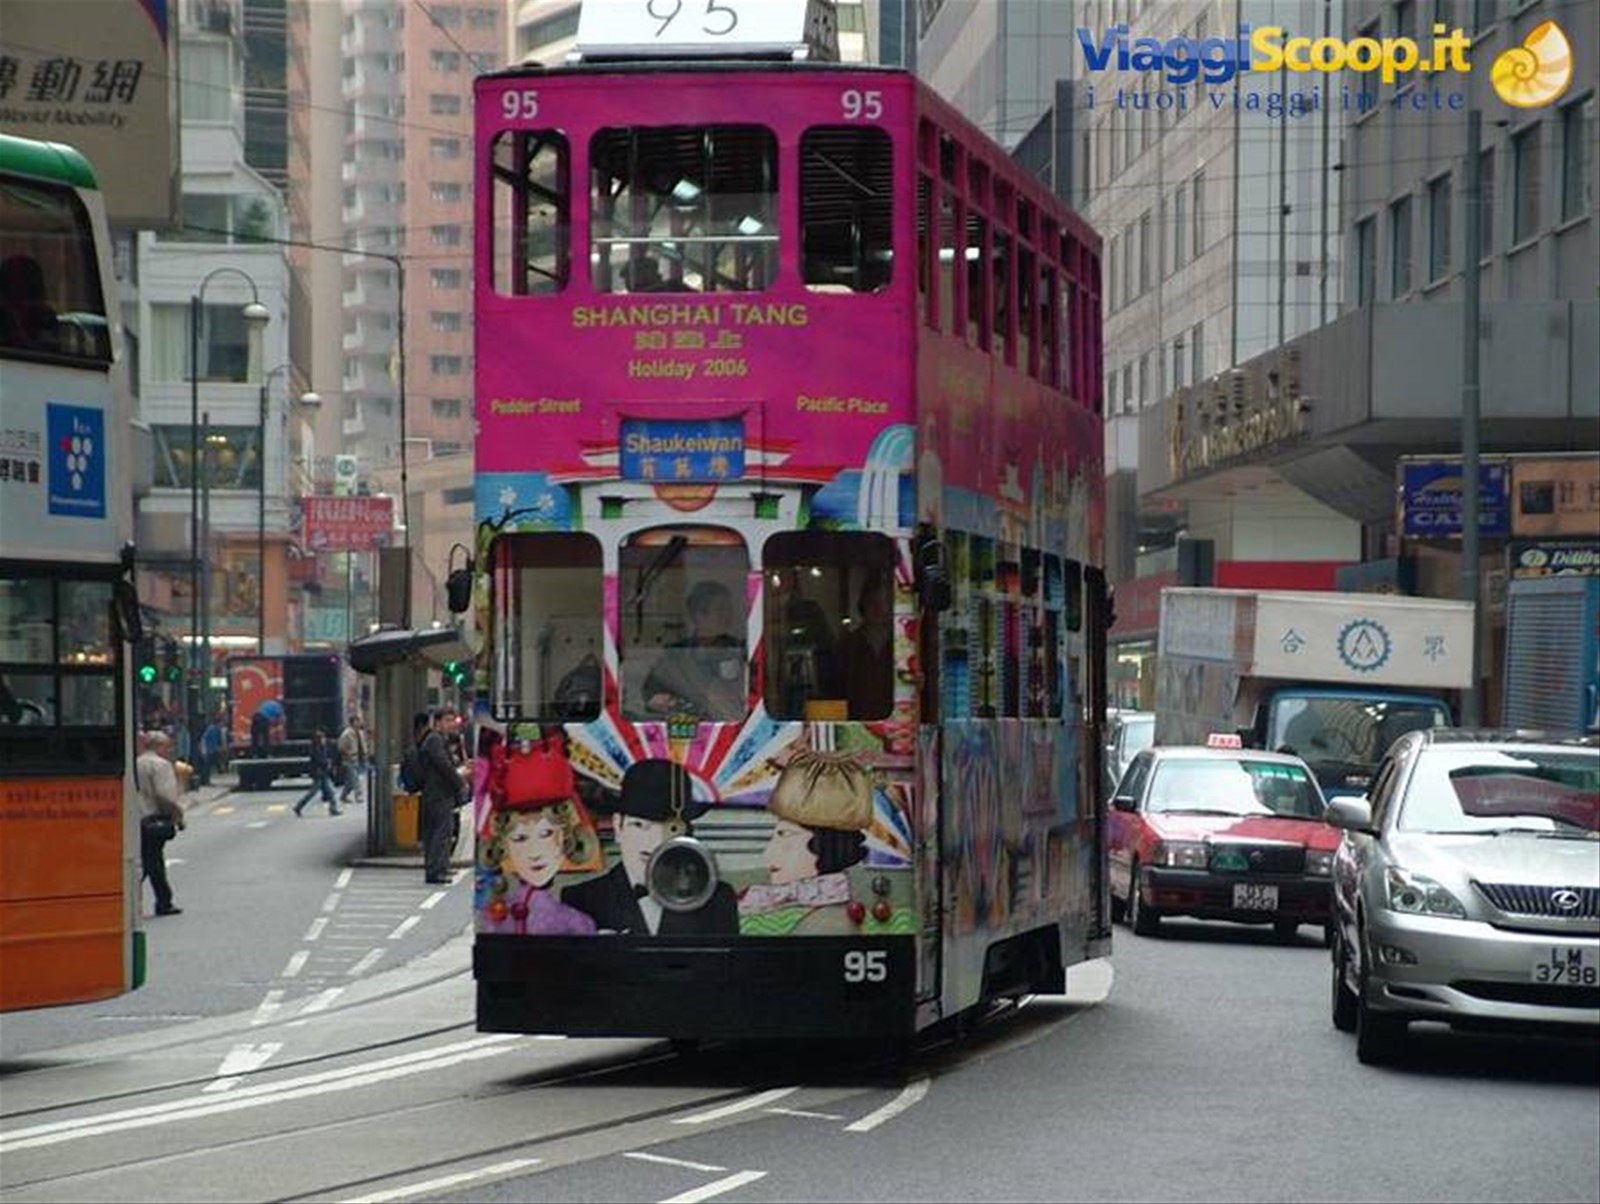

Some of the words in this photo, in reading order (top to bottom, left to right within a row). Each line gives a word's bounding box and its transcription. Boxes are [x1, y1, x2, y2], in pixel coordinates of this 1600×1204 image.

[647, 0, 738, 37] 95
[502, 91, 539, 120] 95
[841, 90, 883, 119] 95
[572, 304, 719, 327] SHANGHAI
[730, 304, 808, 326] TANG
[628, 359, 695, 379] Holiday
[704, 358, 748, 377] 2006
[539, 397, 581, 414] Street
[796, 395, 846, 412] Pacific
[847, 396, 890, 414] Place
[625, 432, 743, 454] Shaukeiwan
[1279, 628, 1306, 655] 合
[844, 950, 888, 982] 95
[1552, 947, 1582, 966] LM
[1536, 963, 1597, 985] 3798
